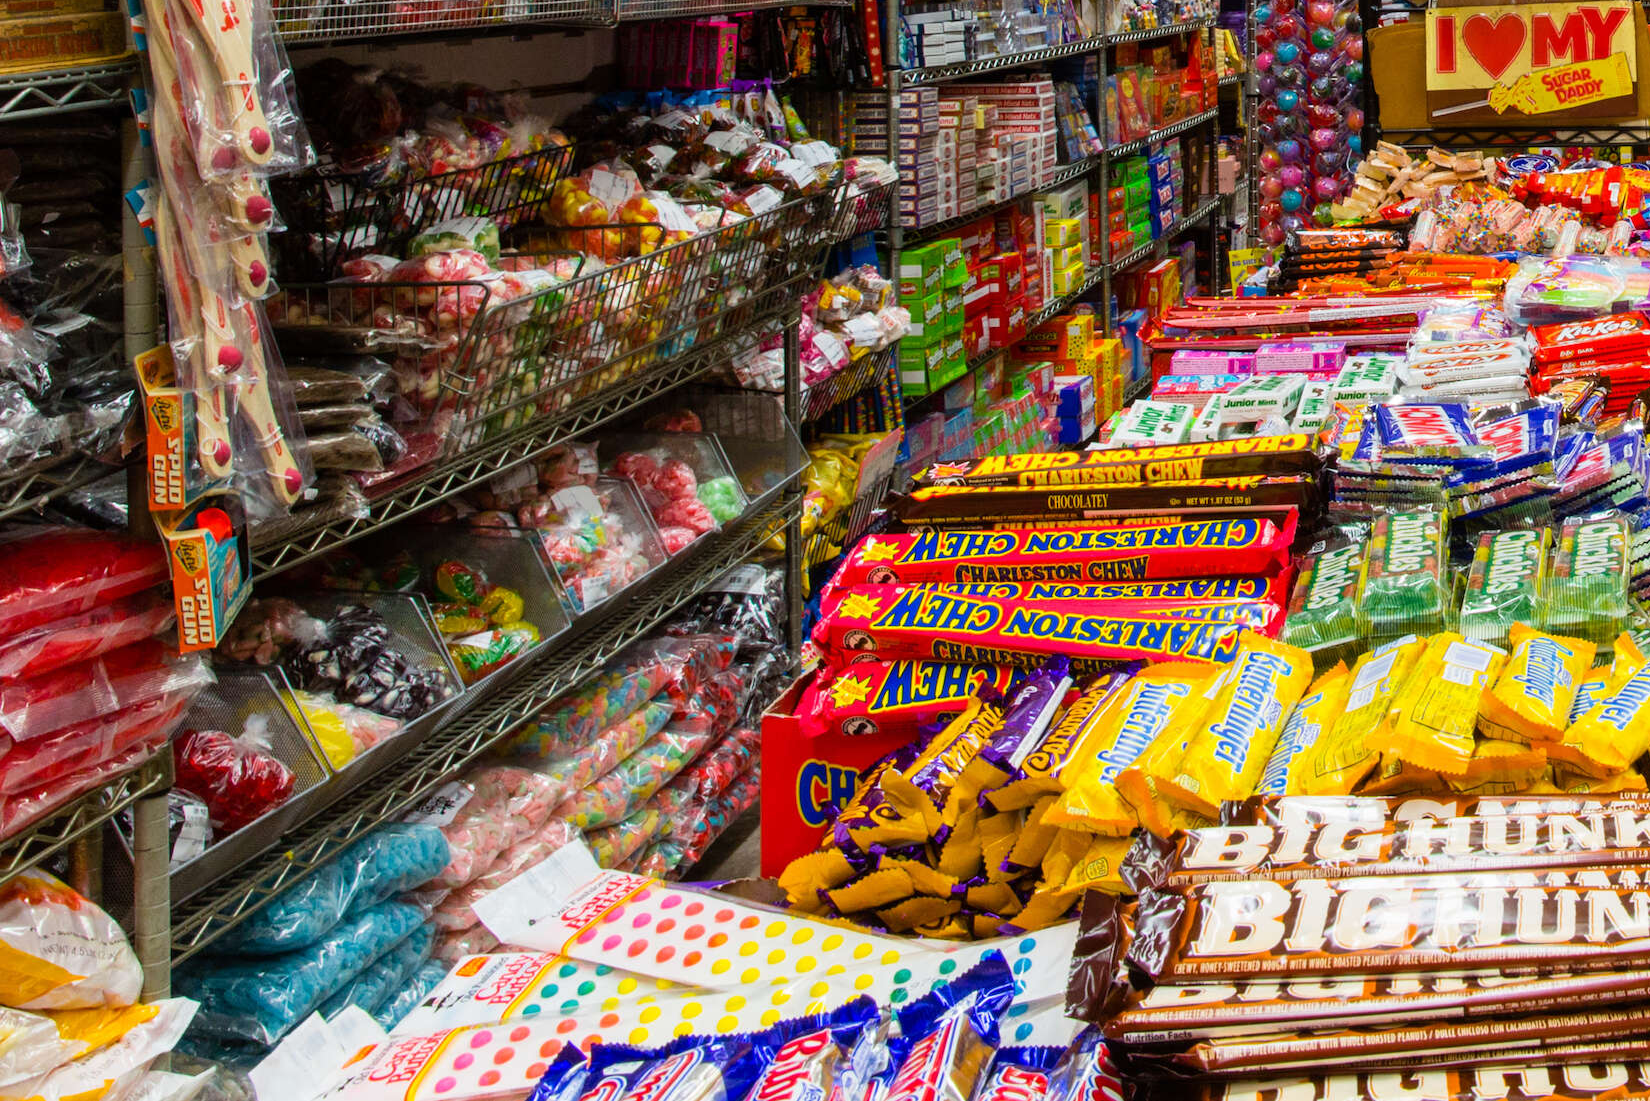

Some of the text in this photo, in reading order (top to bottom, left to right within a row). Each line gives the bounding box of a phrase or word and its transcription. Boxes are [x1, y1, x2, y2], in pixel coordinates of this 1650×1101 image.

[1436, 6, 1631, 73] I MY
[1541, 69, 1591, 92] SUGAR
[1554, 78, 1604, 105] DADDY
[1224, 397, 1278, 410] Junior Mints
[1334, 390, 1367, 401] Junior
[153, 454, 167, 504] GUN
[167, 437, 181, 505] SPUD
[1018, 458, 1206, 486] CHARLESTON CHEW
[1047, 493, 1110, 511] CHOCOLATEY
[900, 519, 1261, 564] CHARLESTON CHEW
[955, 555, 1149, 583] CHARLESTON CHEW
[181, 595, 199, 645] GUN
[193, 577, 213, 644] SPUD
[872, 588, 1243, 665] CHARLESTON CHEW
[1096, 679, 1173, 784] Butterfinger
[1213, 650, 1294, 774] Butterfinger
[1184, 821, 1384, 868] BIG
[1192, 878, 1409, 956] BIG
[1174, 963, 1198, 975] CHEWY,
[1200, 959, 1260, 974] HONEY-SWEETENED
[1262, 959, 1287, 972] NOUGAT
[1289, 959, 1308, 970] WITH
[1309, 958, 1332, 970] WHOLE
[1333, 957, 1361, 969] ROASTED
[1362, 955, 1391, 967] PEANUTS
[1125, 1030, 1193, 1042] Nutrition Facts
[1340, 1036, 1363, 1049] WHOLE
[1365, 1033, 1395, 1046] ROASTED
[1397, 1031, 1426, 1044] PEANUTS
[1434, 1028, 1455, 1040] DULCE
[1457, 1025, 1489, 1037] CHICLOSO
[1490, 1024, 1504, 1034] CON
[1505, 1020, 1547, 1033] CACAHUATES
[1548, 1016, 1588, 1029] ROSTISADOS
[1629, 1010, 1643, 1021] CON
